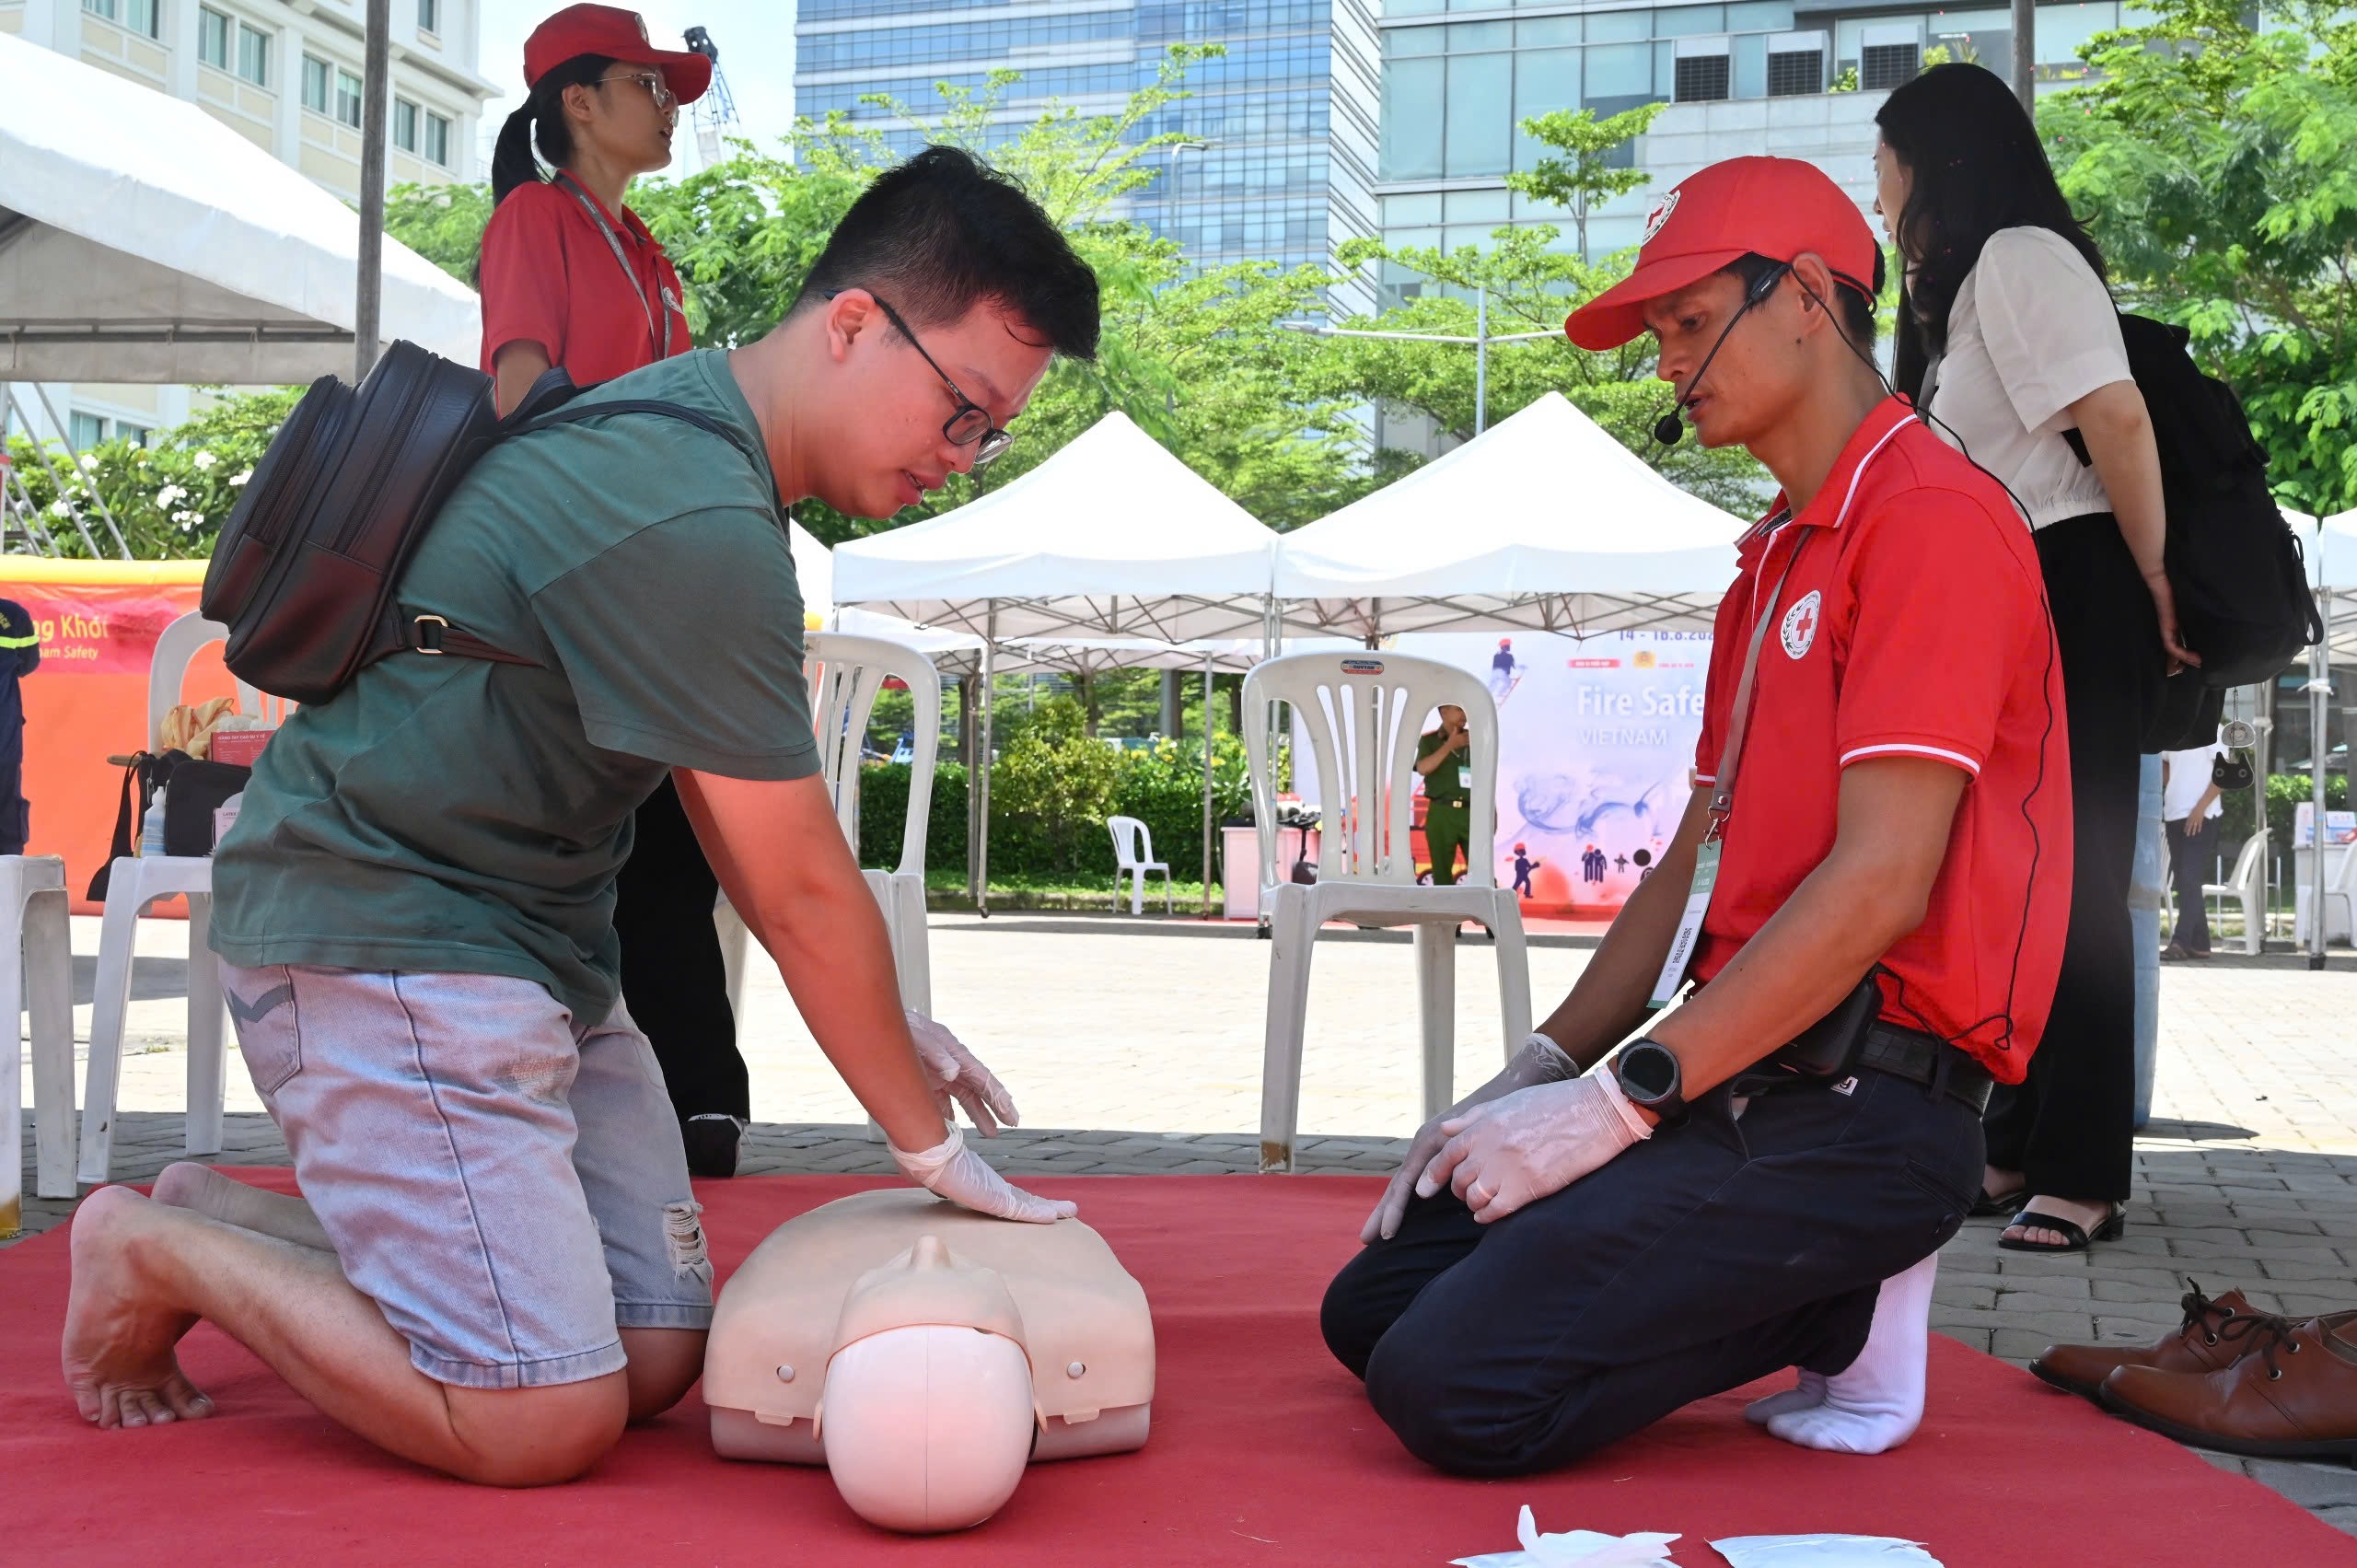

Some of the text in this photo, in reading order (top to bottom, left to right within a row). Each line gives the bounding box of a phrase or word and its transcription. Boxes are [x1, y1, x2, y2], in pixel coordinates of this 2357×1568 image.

[64, 645, 99, 661] Safety
[1577, 684, 1704, 716] Fire Safe
[1578, 728, 1668, 745] VIETNAM
